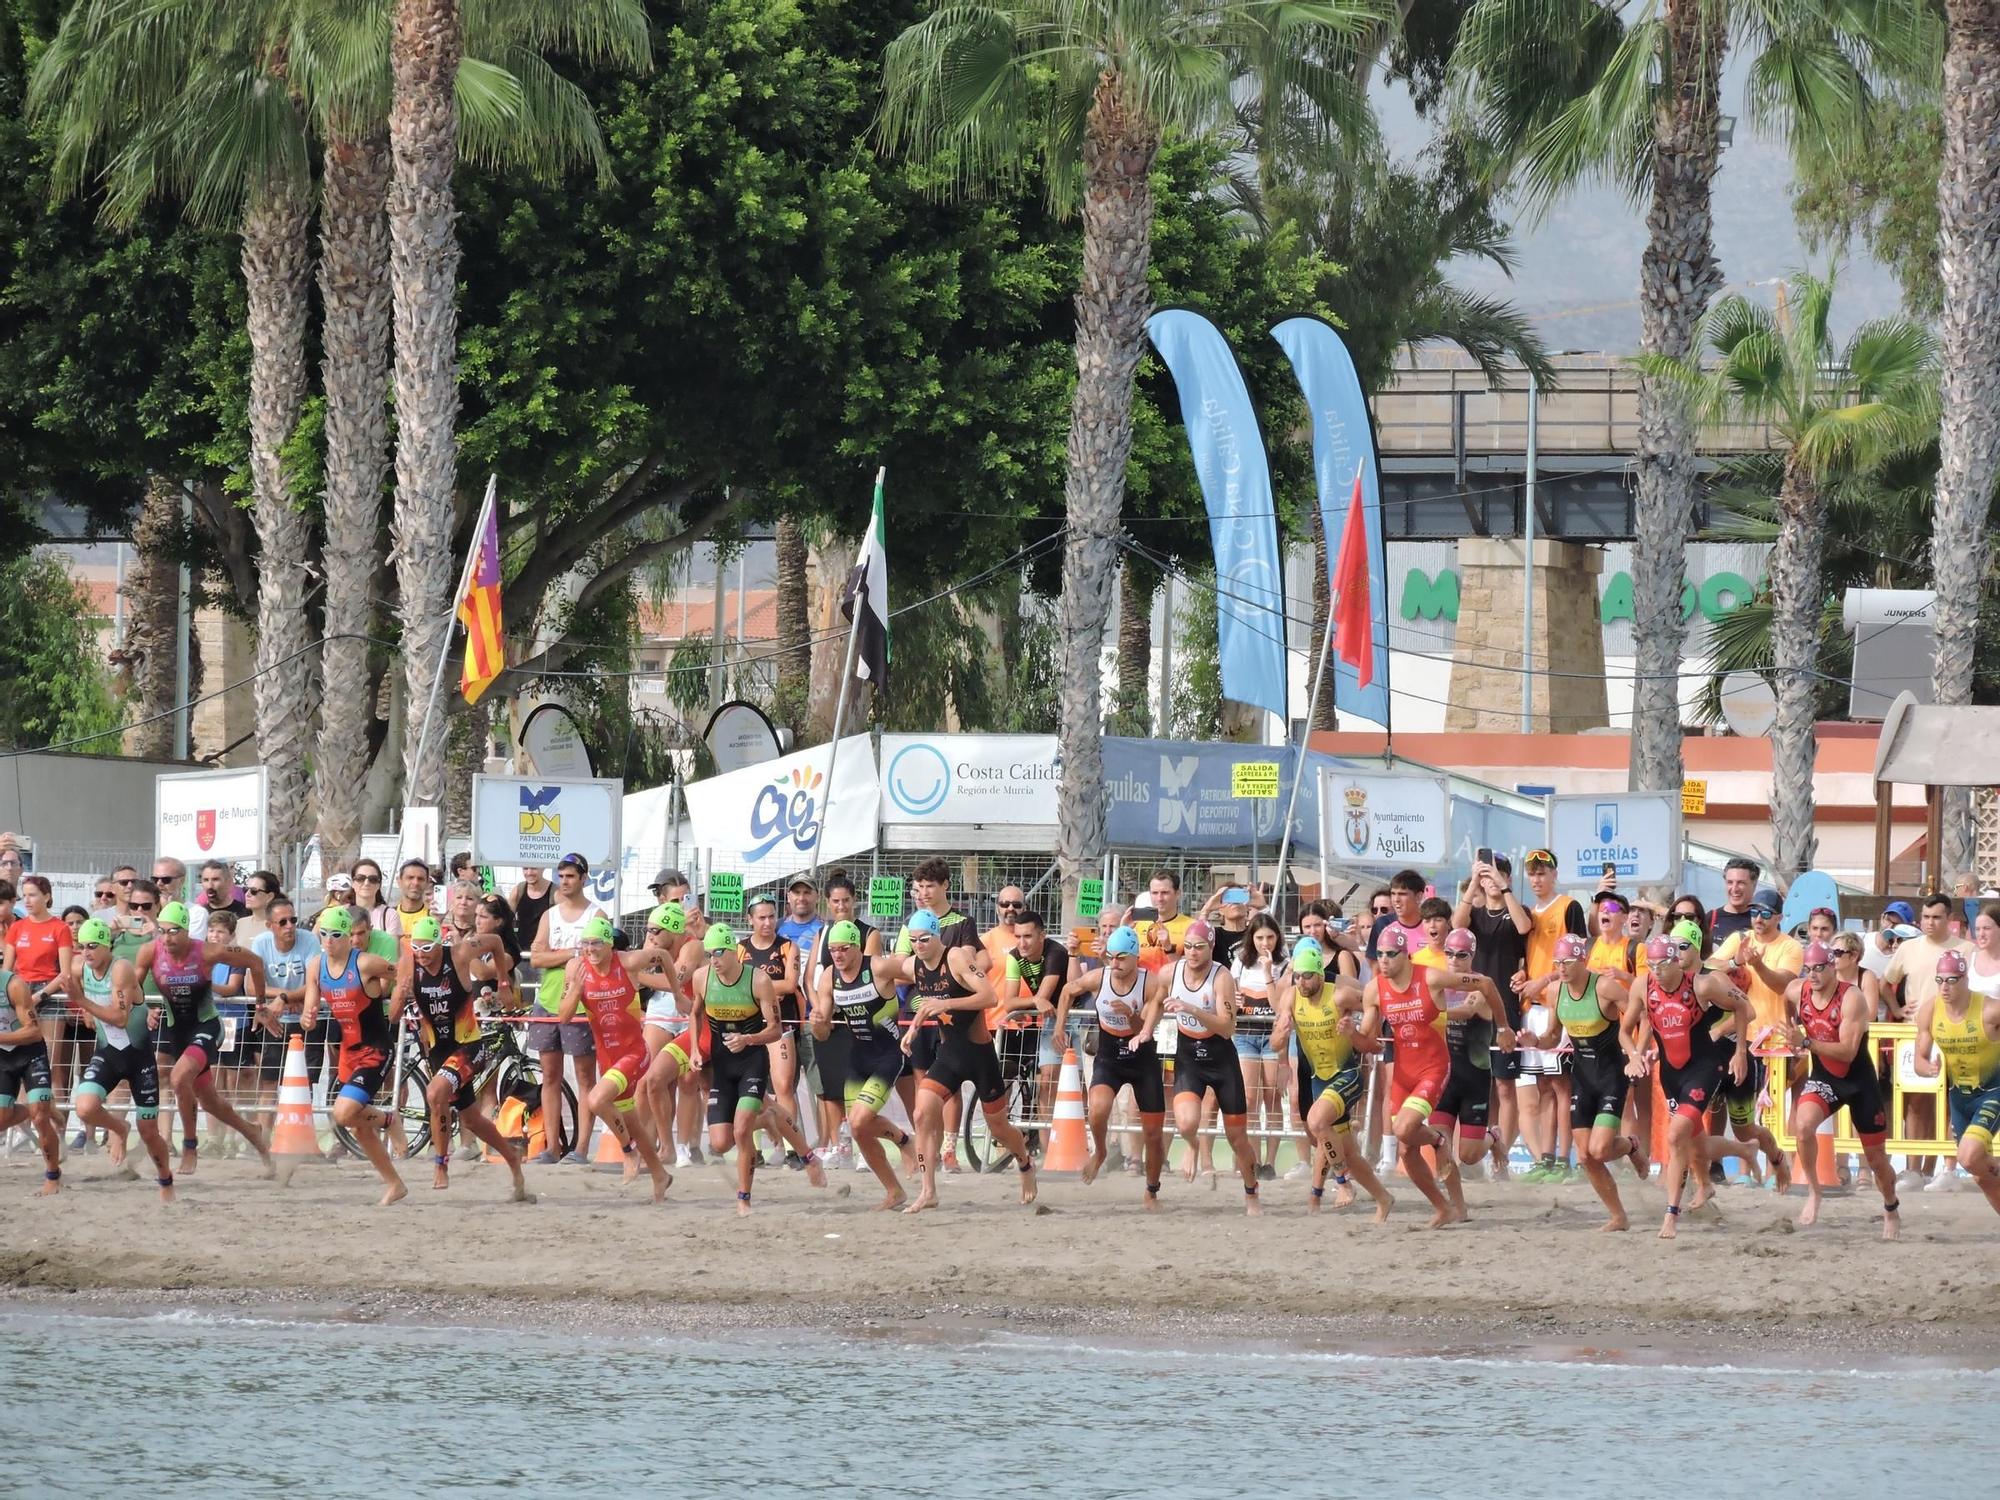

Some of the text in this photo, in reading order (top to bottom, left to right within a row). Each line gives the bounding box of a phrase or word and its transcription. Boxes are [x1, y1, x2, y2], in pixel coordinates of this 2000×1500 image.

[957, 763, 1063, 780] Costa Cálida
[957, 785, 1034, 797] Región de Murcia
[1102, 770, 1150, 812] guilas
[219, 808, 230, 820] de
[1200, 806, 1239, 818] DEPORTIVO
[1373, 812, 1425, 823] Ayuntamiento
[1198, 822, 1237, 834] MUNICIPAL
[1394, 823, 1403, 835] de
[519, 835, 561, 843] PATRONATO
[519, 843, 561, 851] DEPORTIVO
[1376, 833, 1426, 858] Águilas
[519, 852, 561, 860] MUNICIPAL
[1576, 845, 1639, 862] LOTERÍAS
[711, 874, 742, 887] SALIDA
[872, 879, 902, 891] SALIDA
[710, 898, 741, 912] SALIDA
[871, 902, 901, 914] SALIDA
[1129, 940, 1137, 951] 7
[1397, 934, 1405, 947] 9
[1666, 947, 1675, 958] 9
[1958, 961, 1966, 973] 9
[597, 1000, 619, 1012] ORTIZ
[714, 1007, 747, 1019] BERROCAL
[1387, 1009, 1425, 1026] ESCALANTE
